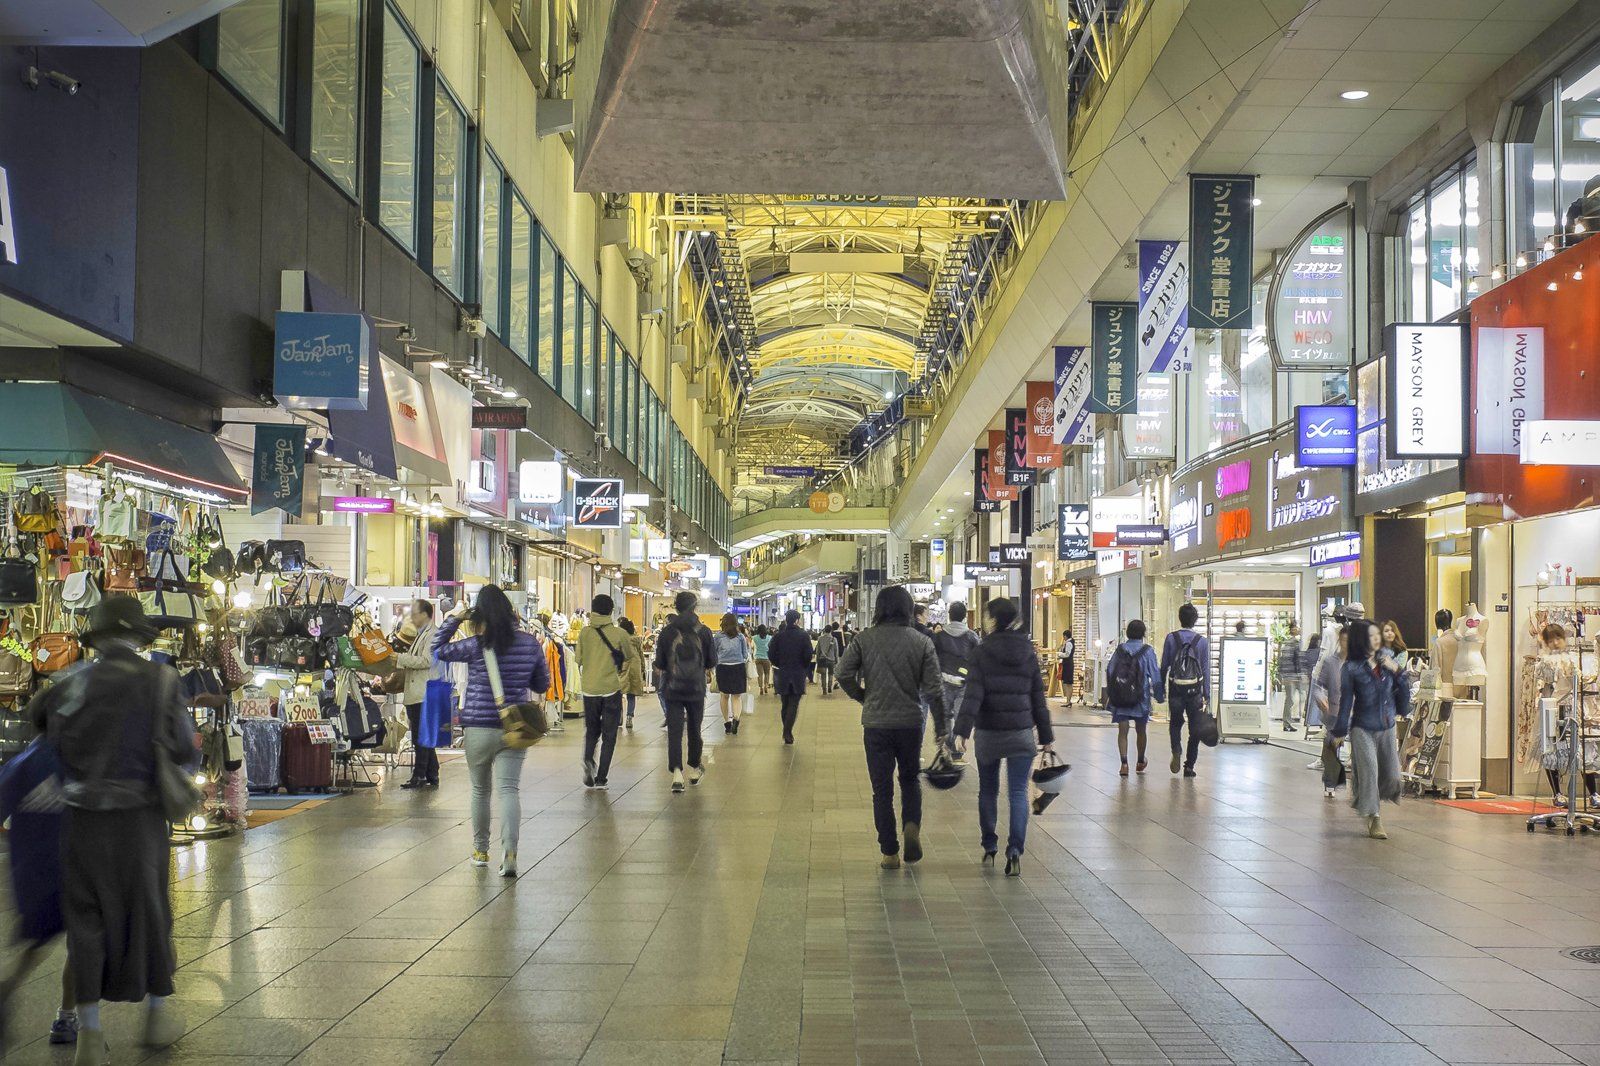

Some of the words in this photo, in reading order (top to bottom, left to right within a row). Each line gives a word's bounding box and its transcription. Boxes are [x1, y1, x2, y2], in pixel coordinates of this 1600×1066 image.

[1211, 182, 1233, 318] ジュンク堂書店
[1141, 267, 1162, 294] SINCE
[1157, 244, 1175, 267] 1882
[1148, 261, 1187, 322] ナガサワ
[1294, 309, 1332, 324] HMV
[1168, 324, 1185, 345] 本店
[1294, 330, 1333, 345] WEGO
[1106, 308, 1124, 407] ジュンク堂書店
[1291, 348, 1322, 360] エイツ
[1056, 365, 1071, 386] SINCE
[1068, 349, 1081, 365] 1882
[1411, 332, 1424, 398] MAYSON
[1136, 421, 1161, 431] HMV
[1411, 406, 1424, 446] GREY
[1036, 456, 1052, 464] B1F
[1013, 474, 1030, 482] B1F
[576, 497, 618, 505] G-SHOCK
[981, 502, 995, 510] B1F
[1005, 547, 1027, 560] VICKY
